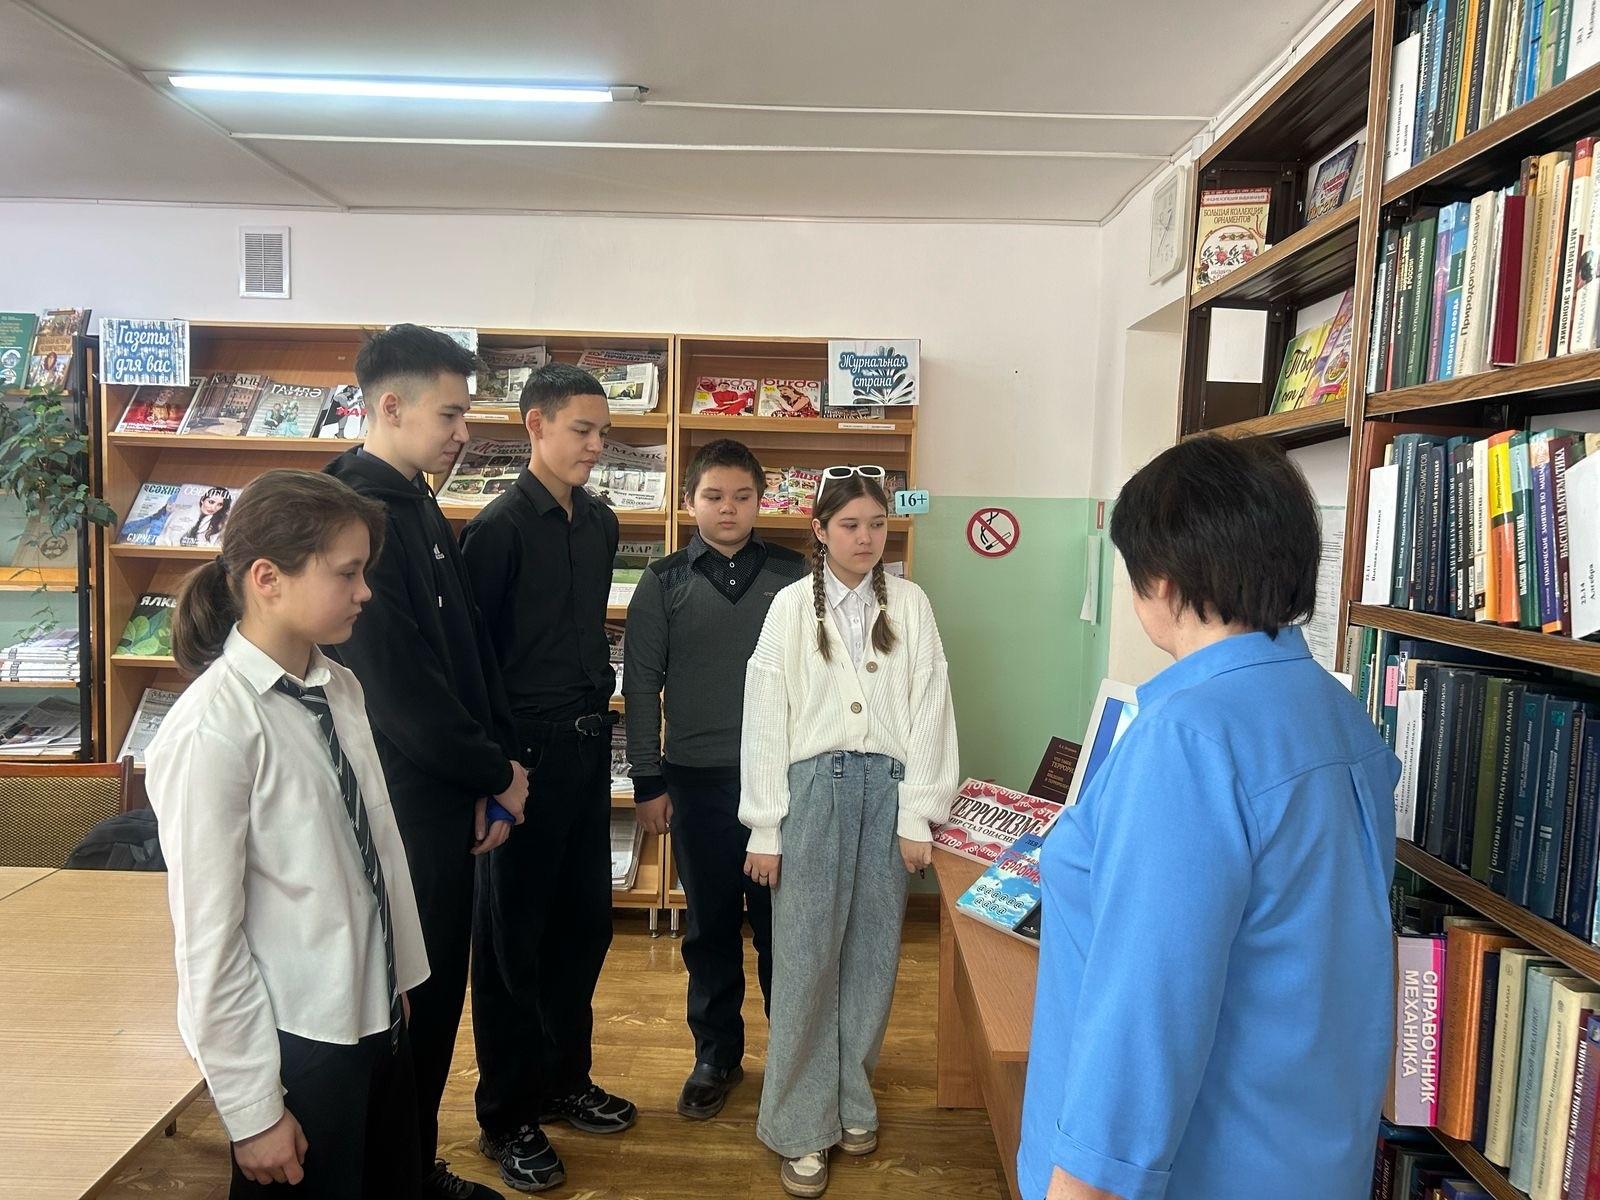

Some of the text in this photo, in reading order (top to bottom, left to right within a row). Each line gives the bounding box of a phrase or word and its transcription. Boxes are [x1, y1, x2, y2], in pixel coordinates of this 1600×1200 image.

[1203, 206, 1264, 217] БОЛЬШАЯ КОЛЛЕКЦИЯ
[1213, 215, 1251, 224] ОРНАМЕНТОВ
[1566, 228, 1577, 284] МАТЕМАТИКА
[118, 325, 171, 352] Газеты
[1446, 298, 1459, 376] ЭКОЛОГИЯ ГОРОДА
[1559, 295, 1570, 345] ЭКОНОМИКЕ
[115, 355, 171, 380] для вас
[840, 352, 907, 374] Журнальная
[763, 378, 819, 389] burda
[853, 377, 893, 395] страна
[1418, 453, 1428, 505] ЭКОНОМИСТОВ
[1431, 459, 1441, 500] математике
[1554, 447, 1568, 514] МАТЕМАТИКА
[899, 492, 928, 508] 16+
[1430, 501, 1439, 528] высшей
[1540, 503, 1549, 533] ЗАНЯТИЯ
[1416, 514, 1425, 559] МАТЕМАТИКА
[1516, 512, 1527, 595] ВЫСШАЯ МАТЕМАТИКА
[1556, 514, 1568, 558] ВЫСШАЯ
[1371, 552, 1379, 581] Высшая
[1414, 560, 1422, 590] ВЫСШАЯ
[1541, 536, 1551, 586] ПРАКТИЧЕСКИЕ
[1587, 562, 1596, 599] Алгебра
[1051, 760, 1074, 774] ТЕРРОРИ
[1433, 718, 1445, 789] МАТЕМАТИЧЕСКОГО
[1000, 788, 1022, 801] STOP
[1399, 750, 1409, 813] Математический
[1490, 690, 1515, 866] ОСНОВЫ МАТЕМАТИЧЕСКОГО АНАЛИЗА
[950, 795, 1040, 838] ТЕРРОРИЗМ
[962, 822, 982, 833] СТАЛ
[982, 828, 1016, 844] ОПАСНЕ
[939, 834, 962, 849] STOP
[980, 846, 998, 859] STOP
[1403, 970, 1420, 1078] МЕХАНИКА
[1421, 970, 1438, 1104] СПРАВОЧНИК
[1562, 1040, 1587, 1191] ОСНОВНЫЕ ЗАКОНЫ МЕХАНИКИ
